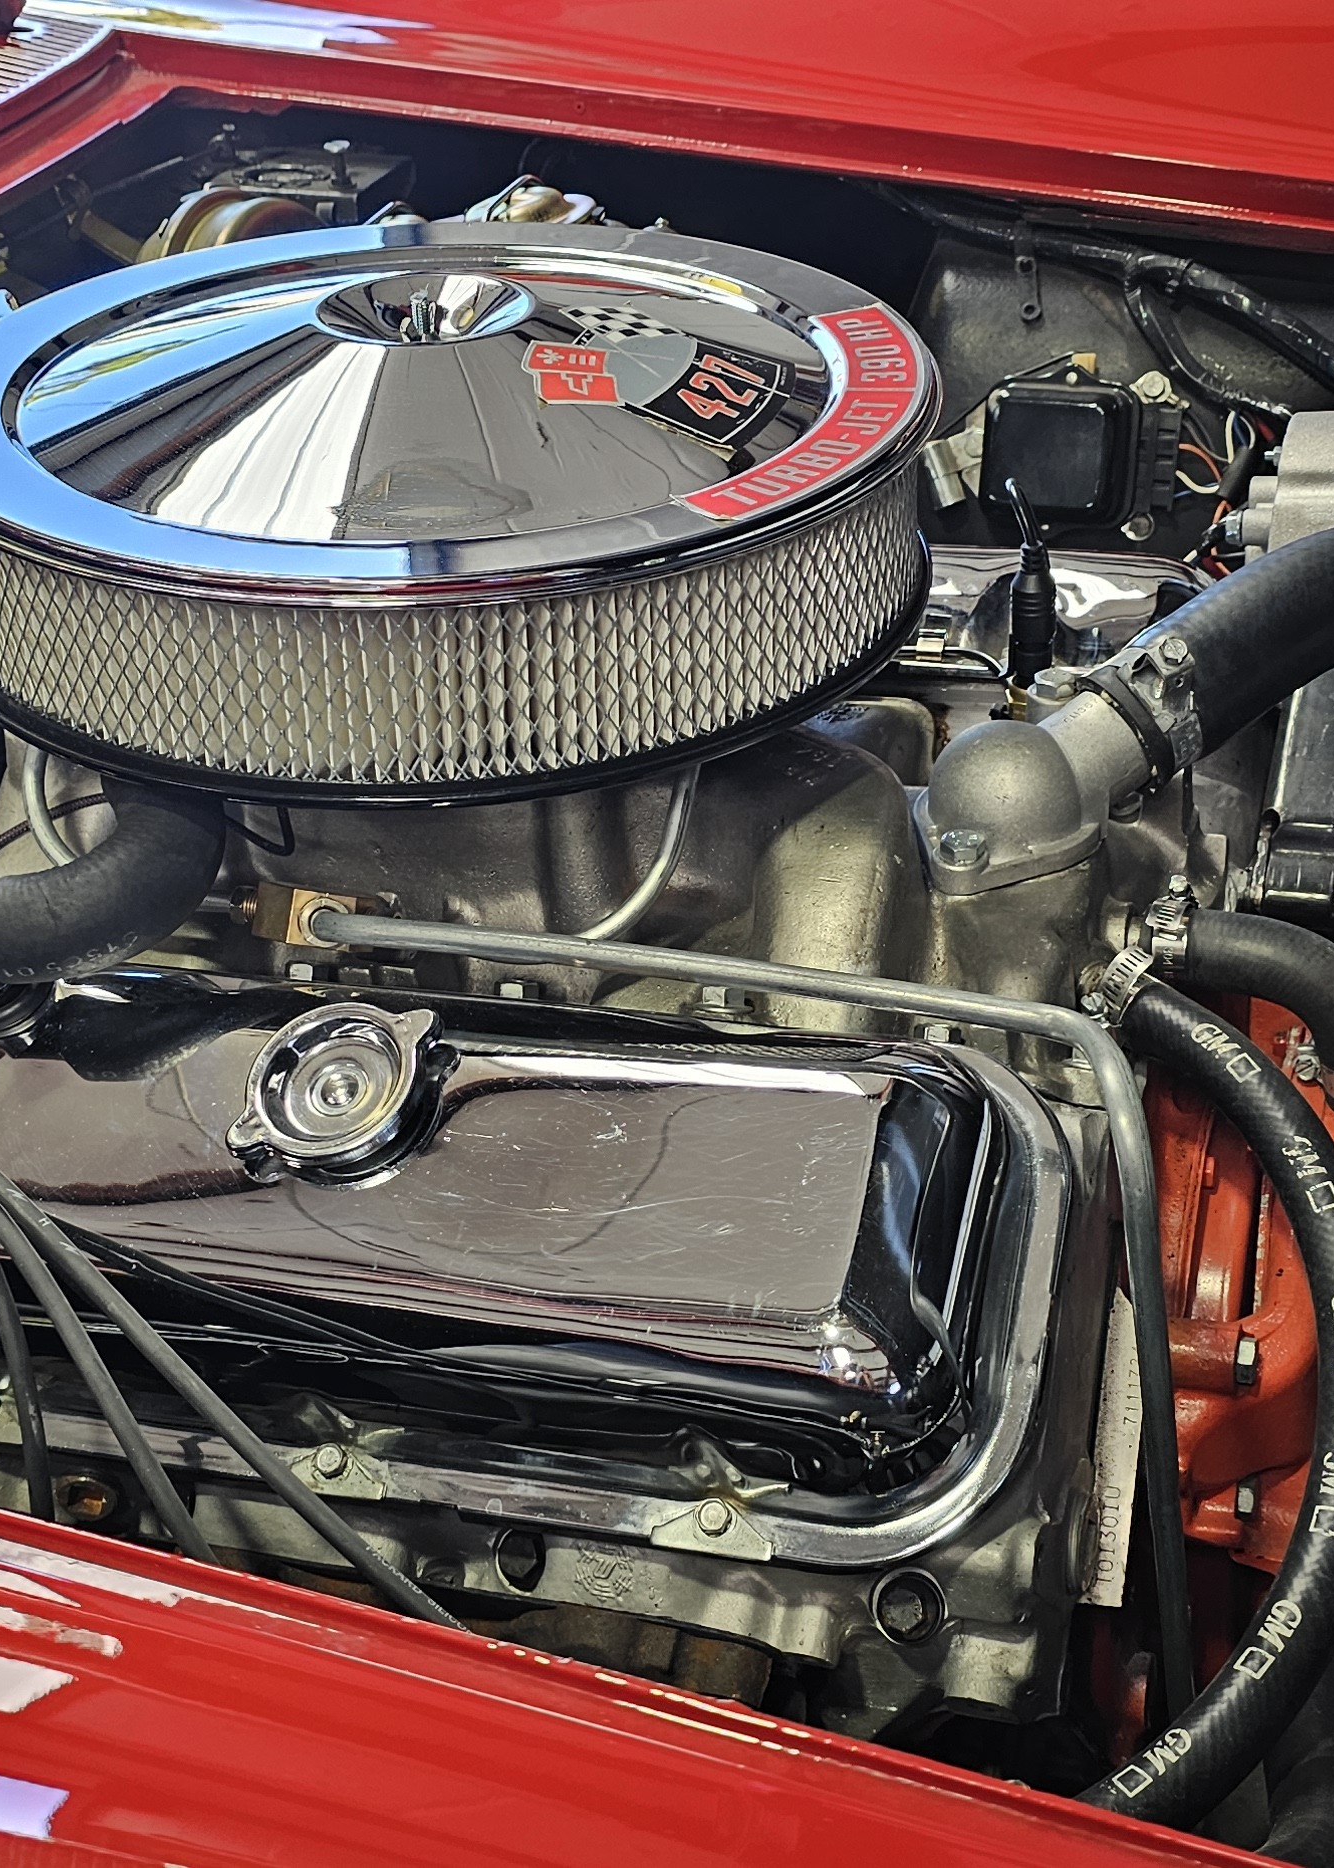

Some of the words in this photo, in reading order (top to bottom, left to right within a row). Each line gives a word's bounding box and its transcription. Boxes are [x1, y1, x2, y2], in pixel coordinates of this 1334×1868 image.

[835, 317, 893, 342] HP
[677, 353, 766, 420] 427
[853, 343, 908, 383] 390
[710, 398, 900, 506] TURBO-JET
[1190, 1020, 1243, 1062] GM
[1257, 1598, 1304, 1653] GM
[1147, 1727, 1194, 1776] GM
